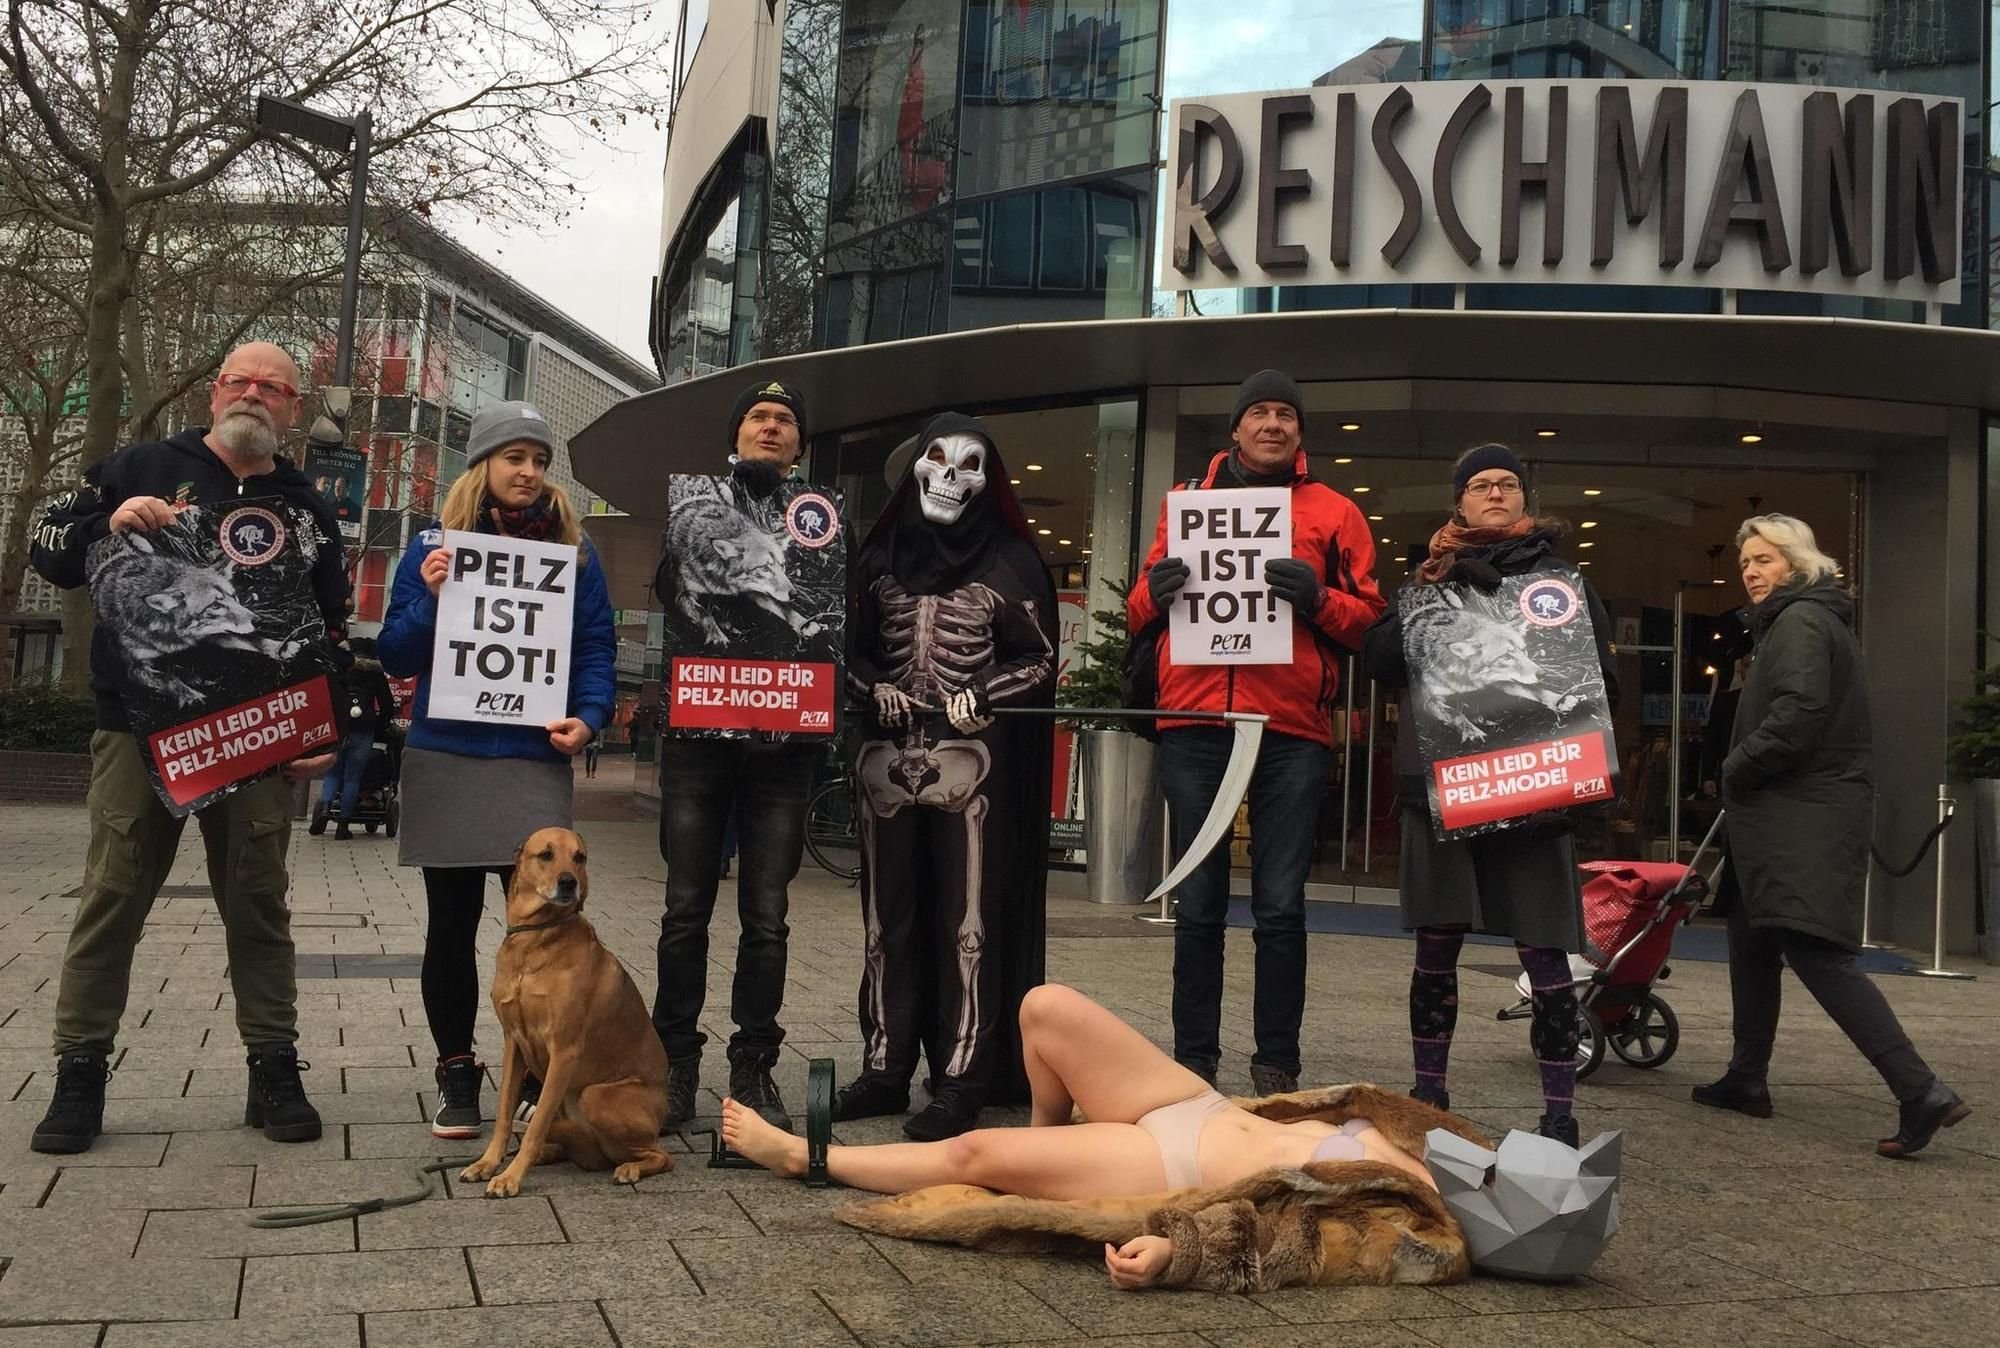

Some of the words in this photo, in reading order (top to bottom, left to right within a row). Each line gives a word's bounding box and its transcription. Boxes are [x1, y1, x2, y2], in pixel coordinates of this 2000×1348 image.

[1173, 82, 1960, 284] REISCHMANN
[1181, 507, 1281, 540] PELZ
[453, 547, 569, 594] PELZ
[1200, 549, 1262, 581] IST
[473, 596, 544, 636] IST
[1183, 590, 1277, 624] TOT!
[449, 640, 557, 686] TOT!
[678, 664, 726, 683] KEIN
[730, 666, 773, 686] LEID
[777, 663, 814, 688] FÜR
[677, 687, 799, 710] PELZ-MODE!
[158, 723, 213, 758] KEIN
[216, 707, 263, 738] LEID
[267, 690, 309, 720] FÜR
[165, 718, 298, 782] PELZ-MODE!
[1441, 759, 1489, 785] KEIN
[1493, 752, 1537, 775] LEID
[1542, 742, 1582, 766] FÜR
[1445, 767, 1568, 806] PELZ-MODE!
[1054, 822, 1084, 832] ONLINE
